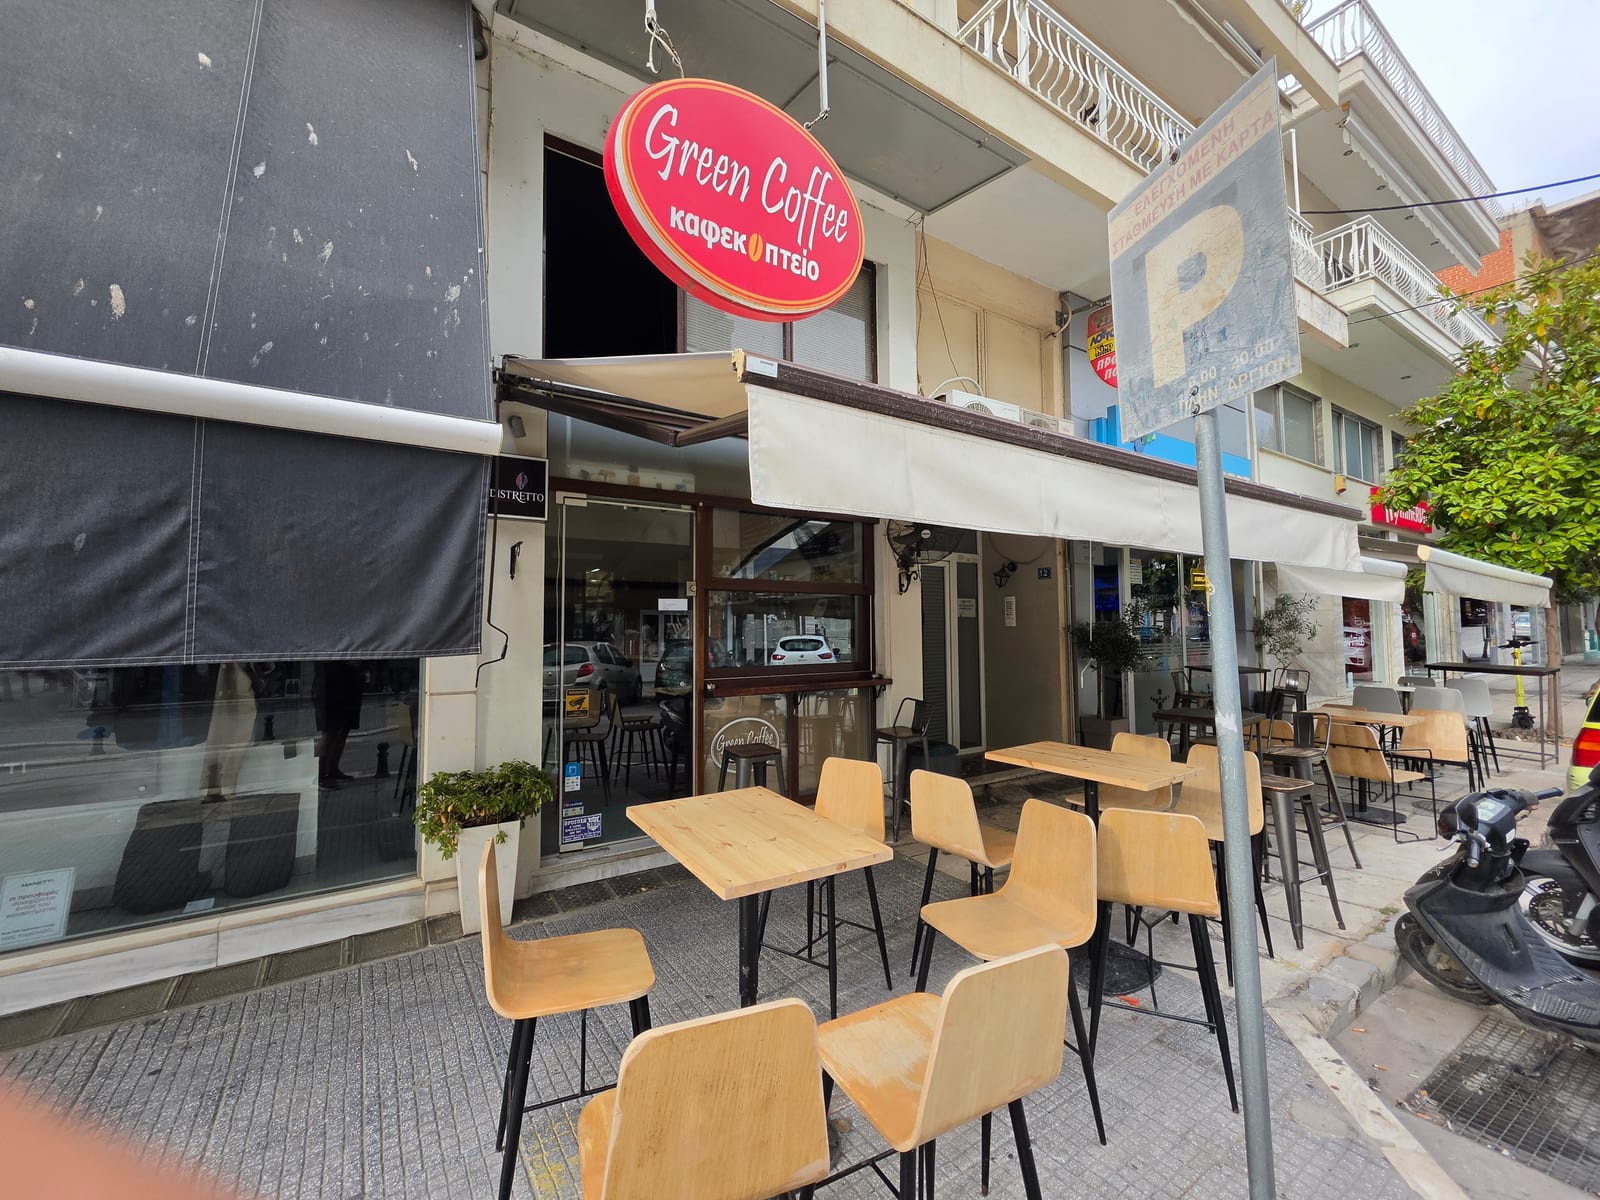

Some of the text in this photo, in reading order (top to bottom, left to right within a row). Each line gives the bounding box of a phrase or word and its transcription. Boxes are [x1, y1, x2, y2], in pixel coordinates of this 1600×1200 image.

[645, 104, 848, 250] Green Coffee
[1112, 110, 1275, 255] ΣΤΑΘΜΕΥΣΗ ΜΕ ΚΑΡΤΑ
[1134, 117, 1236, 217] ΕΛΕΓΧΟΜΕΝΗ
[490, 488, 544, 503] DISTRETTO
